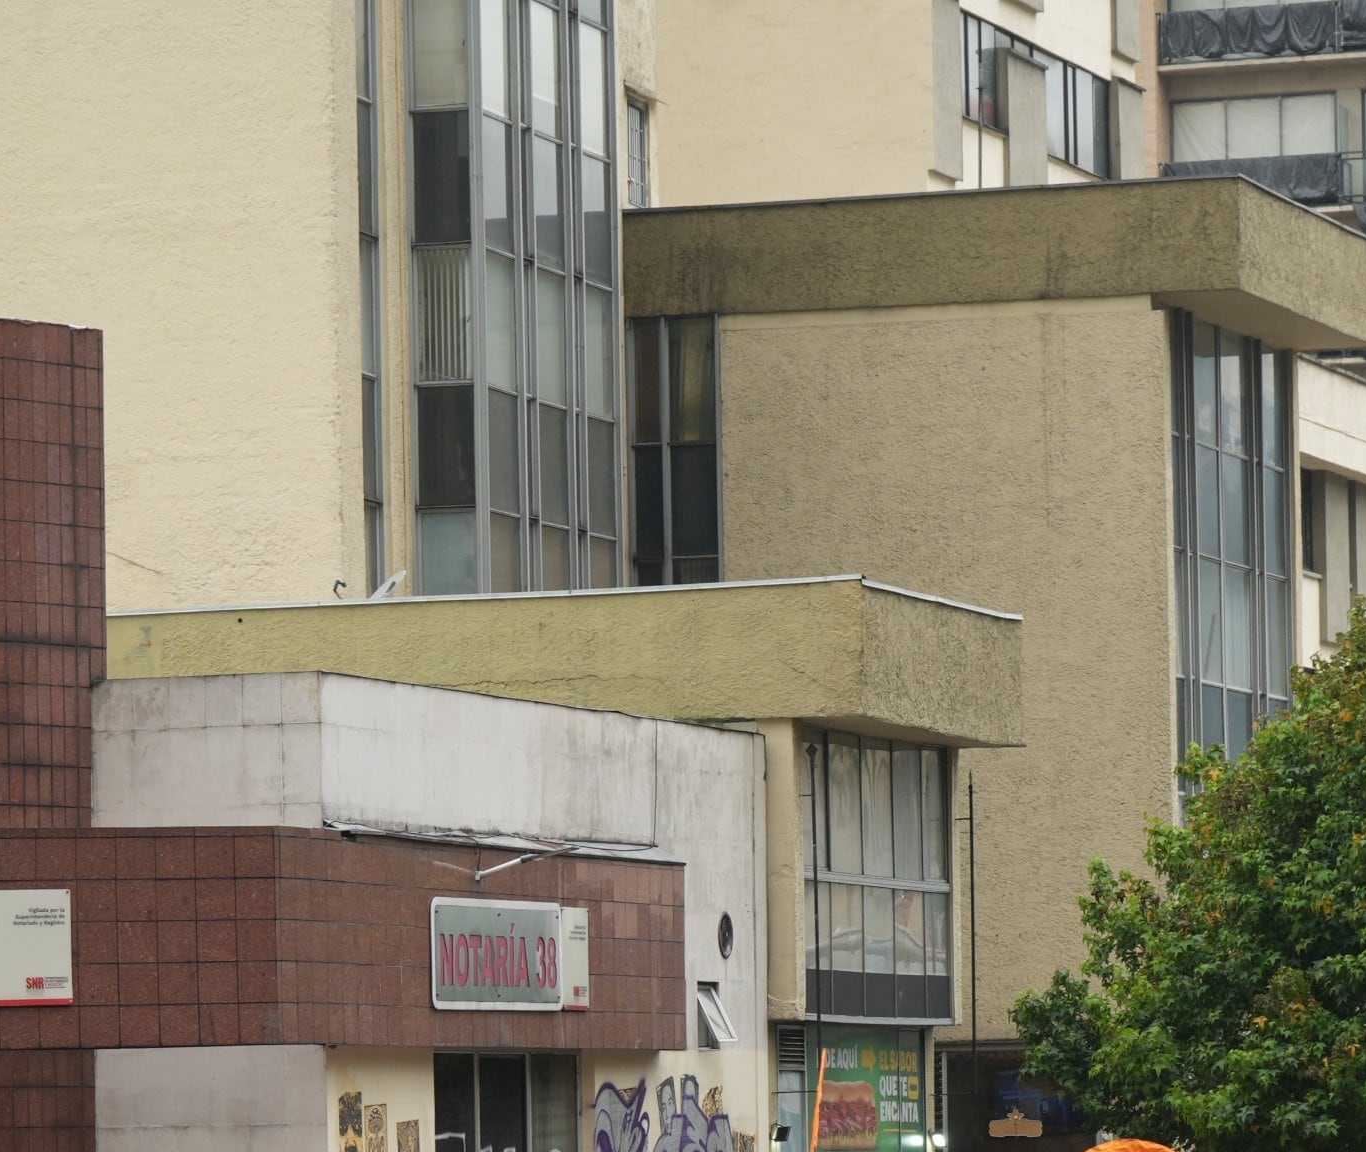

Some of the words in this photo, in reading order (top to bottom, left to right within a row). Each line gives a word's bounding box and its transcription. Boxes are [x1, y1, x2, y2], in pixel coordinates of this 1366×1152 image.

[439, 923, 530, 988] NOTARÍA
[536, 937, 557, 989] 38
[26, 977, 44, 990] SNR
[837, 1044, 858, 1070] AQUÍ
[879, 1050, 889, 1070] EL
[879, 1076, 897, 1098] QUE
[899, 1076, 908, 1097] TE
[880, 1101, 919, 1123] ENCANTA
